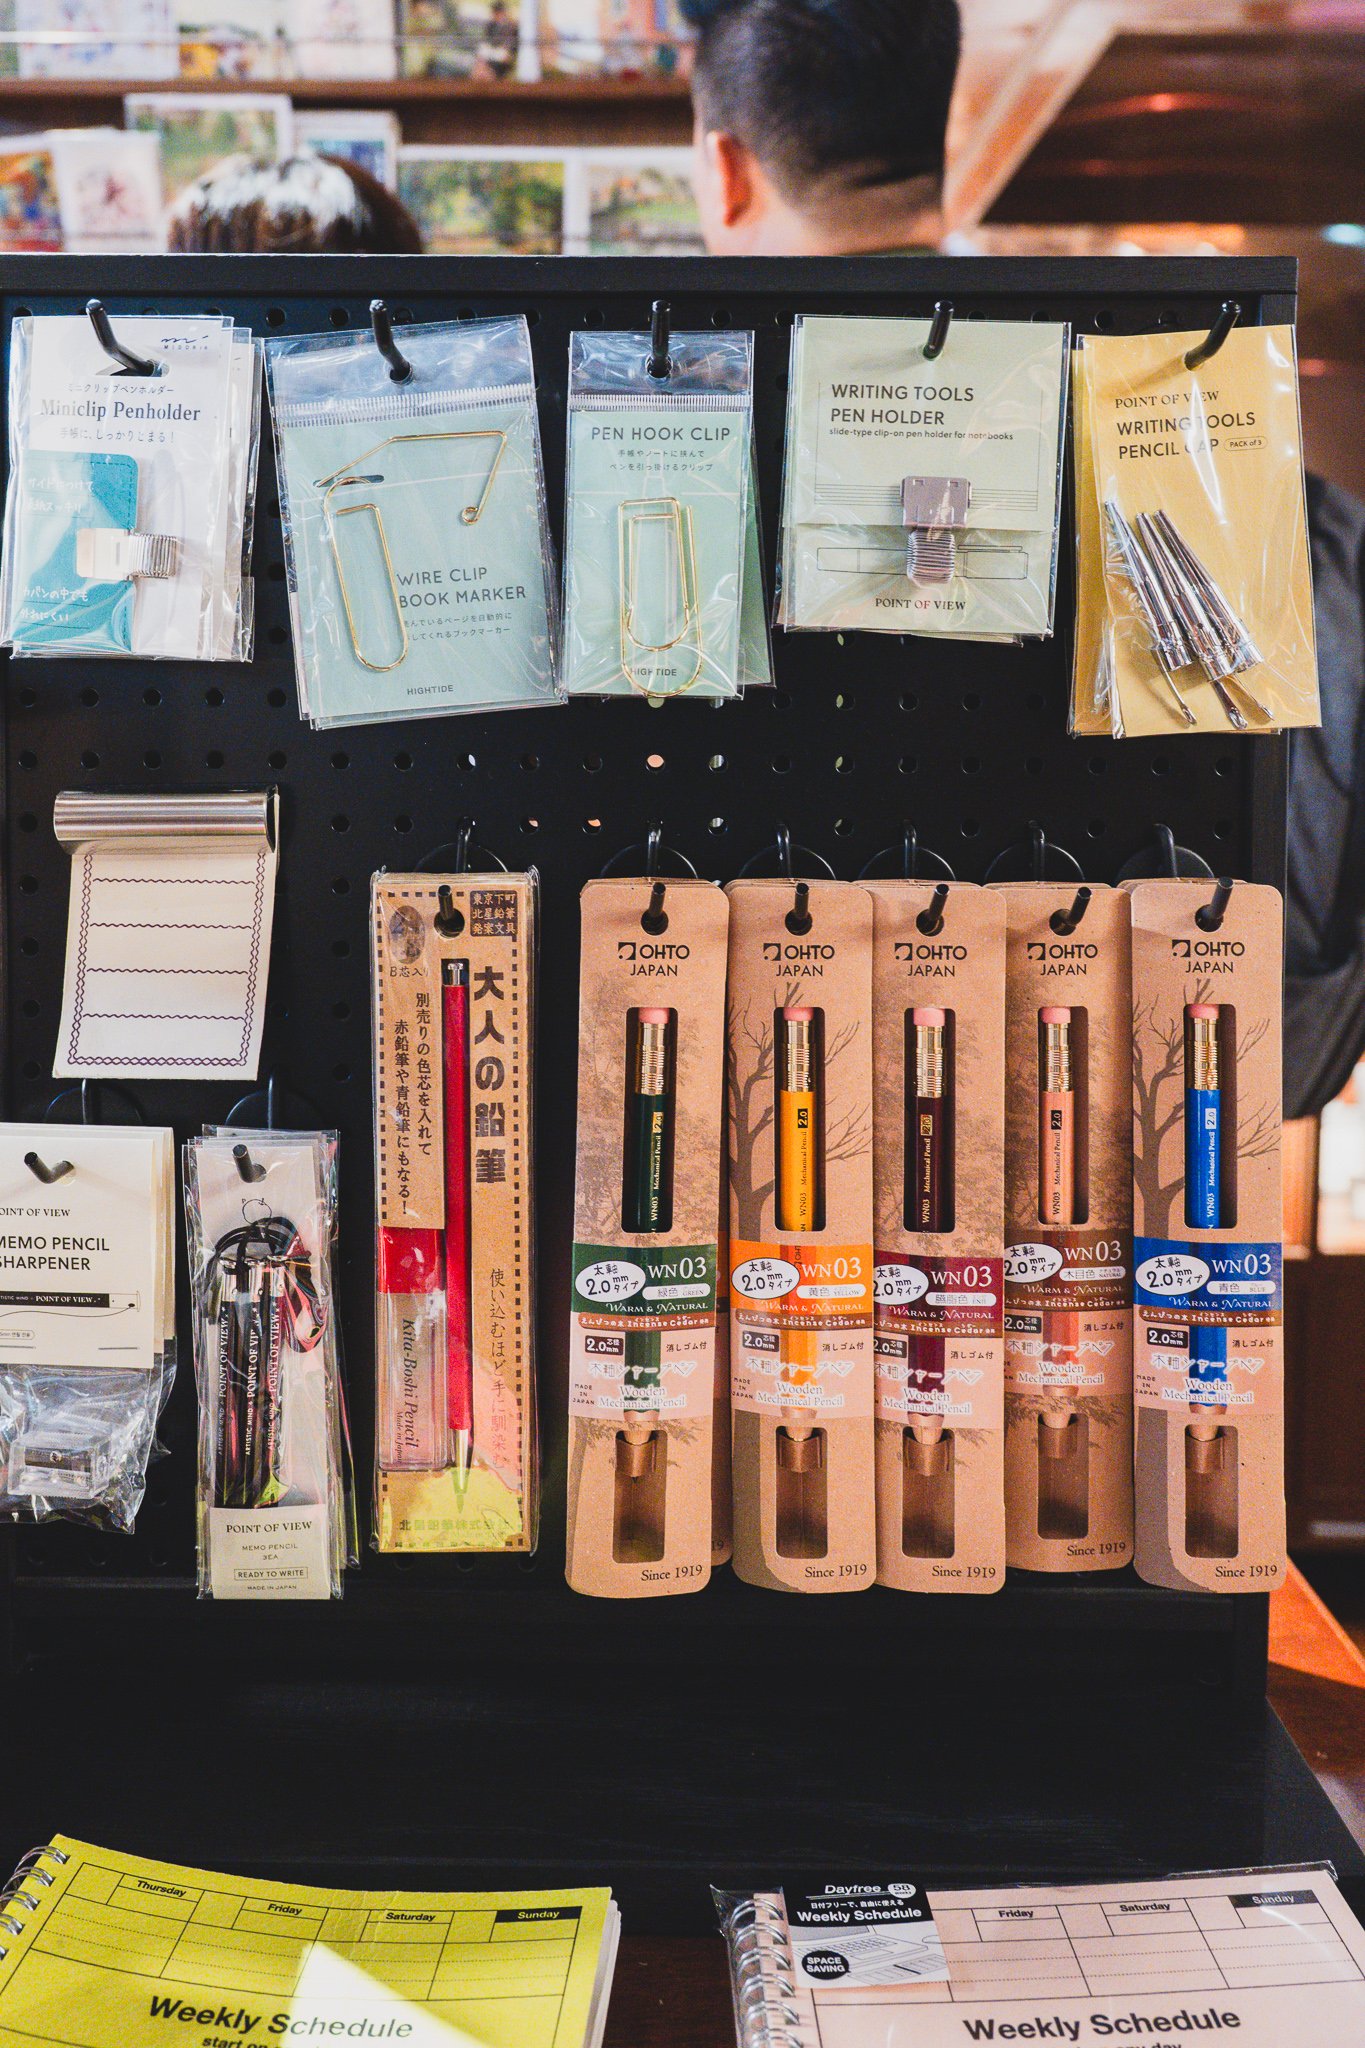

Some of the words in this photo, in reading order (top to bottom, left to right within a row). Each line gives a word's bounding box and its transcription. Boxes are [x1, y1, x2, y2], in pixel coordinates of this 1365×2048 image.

[831, 383, 908, 400] WRITING
[914, 385, 975, 402] TOOLS
[40, 399, 107, 421] Miniclip
[113, 401, 201, 421] Penholder
[830, 408, 865, 423] PEN
[871, 409, 945, 425] HOLDER
[829, 428, 872, 438] slide-type
[874, 428, 904, 439] clip-on
[906, 430, 922, 439] pen
[924, 429, 952, 439] holder
[954, 430, 966, 439] for
[1117, 417, 1192, 436] WRITING
[591, 427, 624, 441] PEN
[632, 427, 684, 441] HOOK
[691, 427, 731, 441] CLIP
[1119, 442, 1180, 459] PENCIL
[396, 570, 443, 586] WIRE
[450, 567, 488, 582] CLIP
[399, 592, 450, 609] BOOK
[456, 585, 527, 604] MARKER
[875, 598, 911, 609] POINT
[914, 599, 930, 610] OF
[934, 600, 966, 610] VIEW
[406, 684, 455, 696] HIGHTIDE
[639, 944, 690, 960] OHTO
[784, 944, 835, 961] OHTO
[915, 944, 968, 961] OHTO
[1049, 943, 1098, 960] OHTO
[1193, 941, 1245, 957] OHTO
[629, 964, 678, 977] JAPAN
[776, 964, 824, 977] JAPAN
[907, 964, 956, 977] JAPAN
[1040, 963, 1087, 976] JAPAN
[1185, 961, 1234, 974] JAPAN
[415, 992, 433, 1156] 別売りの色芯を入れて
[473, 965, 507, 1184] 大人の鉛筆
[1208, 1131, 1216, 1151] Pencil
[1208, 1151, 1216, 1186] Mechanical
[1052, 1191, 1060, 1215] WN03
[922, 1199, 930, 1223] WN03
[0, 1236, 47, 1250] MEMO
[52, 1237, 110, 1251] PENCIL
[1063, 1240, 1122, 1261] WN03
[647, 1256, 707, 1279] WN03
[801, 1256, 862, 1279] WN03
[1031, 1263, 1056, 1275] タイプ
[1212, 1253, 1272, 1275] WN03
[742, 1275, 766, 1292] 2.0
[767, 1272, 783, 1280] mm
[930, 1266, 992, 1287] WN03
[1146, 1271, 1173, 1288] 2.0
[1175, 1268, 1192, 1276] mm
[1176, 1275, 1203, 1286] タイプ
[585, 1278, 611, 1296] 2.0
[613, 1281, 639, 1294] タイプ
[768, 1278, 793, 1290] タイプ
[896, 1285, 922, 1297] タイプ
[627, 1320, 668, 1328] Incense
[669, 1318, 698, 1327] Cedar
[782, 1318, 823, 1326] Incense
[825, 1318, 855, 1326] Cedar
[1191, 1315, 1233, 1323] Incense
[1235, 1315, 1264, 1323] Cedar
[1083, 1322, 1125, 1332] 消しゴム付
[666, 1341, 707, 1353] 消しゴム付
[822, 1342, 864, 1352] 消しゴム付
[1232, 1339, 1274, 1348] 消しゴム付
[402, 1318, 419, 1398] Kita-Boshi
[950, 1351, 994, 1360] 消しゴム付
[1038, 1362, 1084, 1374] Wooden
[1018, 1373, 1073, 1384] Mechanical
[1076, 1374, 1104, 1384] Pencil
[1184, 1378, 1233, 1391] Wooden
[619, 1385, 666, 1397] Wooden
[777, 1382, 823, 1394] Wooden
[904, 1388, 950, 1401] Wooden
[599, 1396, 653, 1408] Mechanical
[654, 1396, 686, 1408] Pencil
[757, 1393, 811, 1406] Mechanical
[814, 1395, 843, 1406] Pencil
[1163, 1389, 1220, 1402] Mechanical
[1222, 1391, 1254, 1403] Pencil
[883, 1398, 938, 1412] Mechanical
[941, 1403, 971, 1414] Pencil
[404, 1401, 419, 1449] Pencil
[226, 1524, 261, 1533] POINT
[263, 1523, 279, 1533] OF
[282, 1521, 312, 1531] VIEW
[1066, 1545, 1095, 1556] Since
[1099, 1542, 1127, 1555] 1919
[280, 1569, 304, 1577] WRITE
[641, 1569, 671, 1581] Since
[675, 1565, 703, 1579] 1919
[804, 1567, 835, 1578] Since
[838, 1564, 867, 1576] 1919
[931, 1565, 962, 1577] Since
[966, 1566, 996, 1578] 1919
[1215, 1566, 1245, 1577] Since
[1249, 1565, 1277, 1577] 1919
[824, 1884, 882, 1896] Dayfree
[136, 1879, 187, 1898] Thursday
[267, 1901, 303, 1916] Friday
[385, 1910, 436, 1923] Saturday
[516, 1908, 560, 1921] Sunday
[811, 1900, 904, 1909] 日付フリーで、自由に使える
[998, 1908, 1035, 1921] Friday
[1119, 1901, 1171, 1913] Saturday
[1251, 1893, 1295, 1906] Sunday
[796, 1911, 851, 1923] Weekly
[854, 1907, 922, 1921] Schedule
[807, 1957, 842, 1965] SPACE
[806, 1964, 845, 1973] SAVING
[149, 1995, 262, 2034] Weekly
[267, 2012, 413, 2038] Schedule
[962, 2016, 1081, 2041] Weekly
[1089, 2008, 1241, 2035] Schedule
